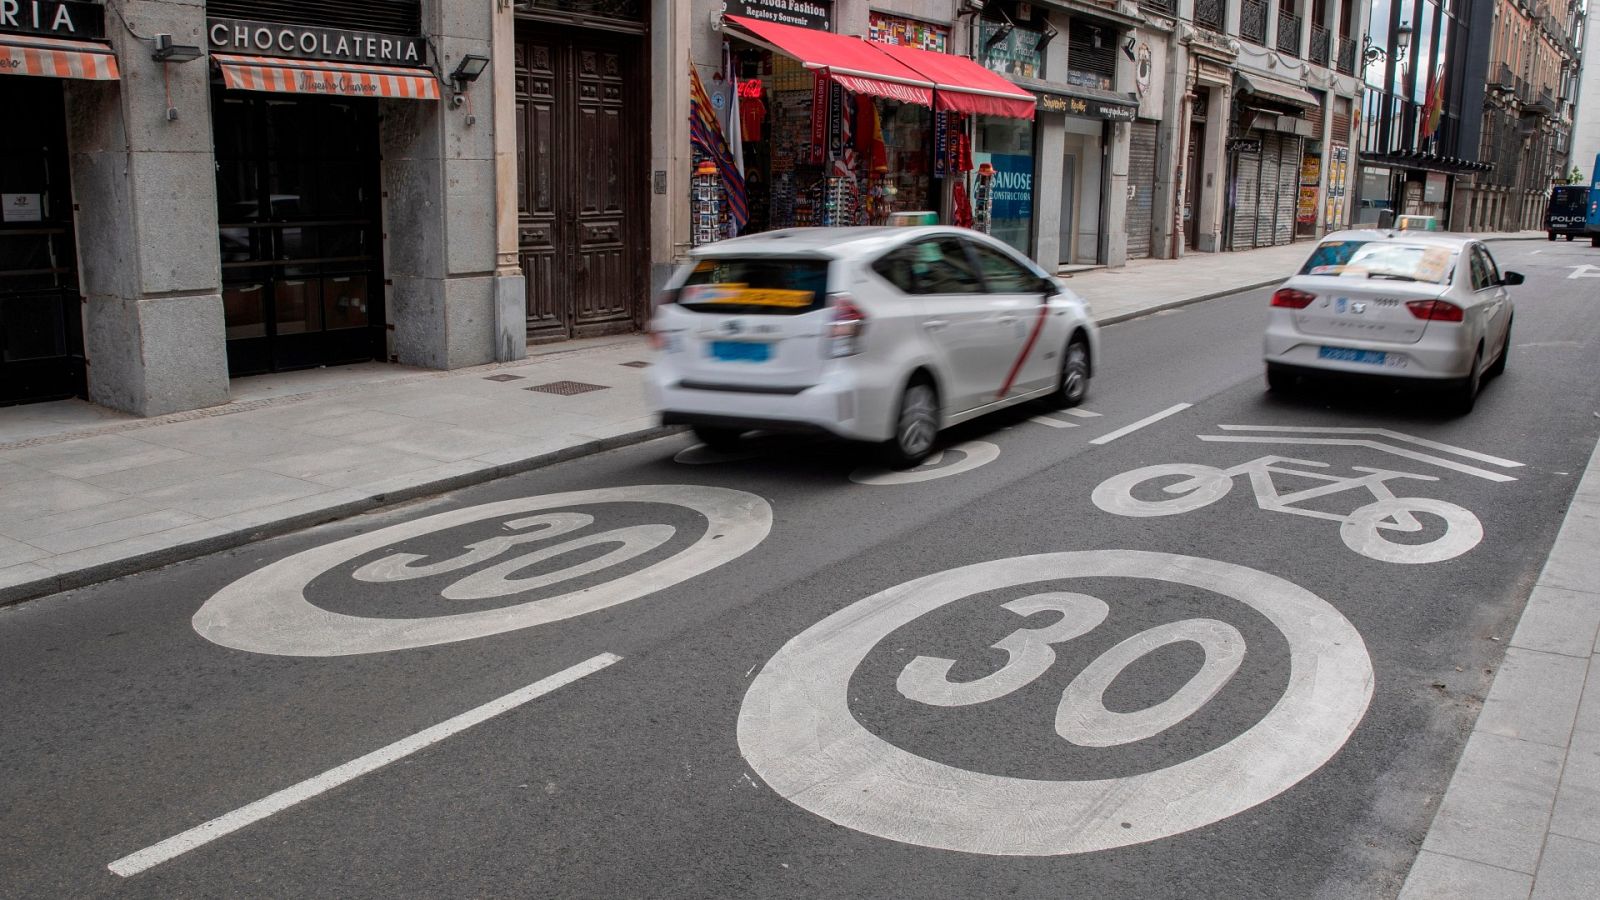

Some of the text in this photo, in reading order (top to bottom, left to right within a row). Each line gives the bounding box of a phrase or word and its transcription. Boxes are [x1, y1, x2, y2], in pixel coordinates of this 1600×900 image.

[746, 6, 808, 26] Regalos y Souvenir
[788, 0, 826, 17] Fashion
[210, 23, 418, 61] CHOCOLATERIA
[832, 83, 841, 134] REAL MADRI
[950, 111, 958, 157] ARCELONA
[352, 512, 676, 600] 30
[896, 592, 1246, 747] 30
